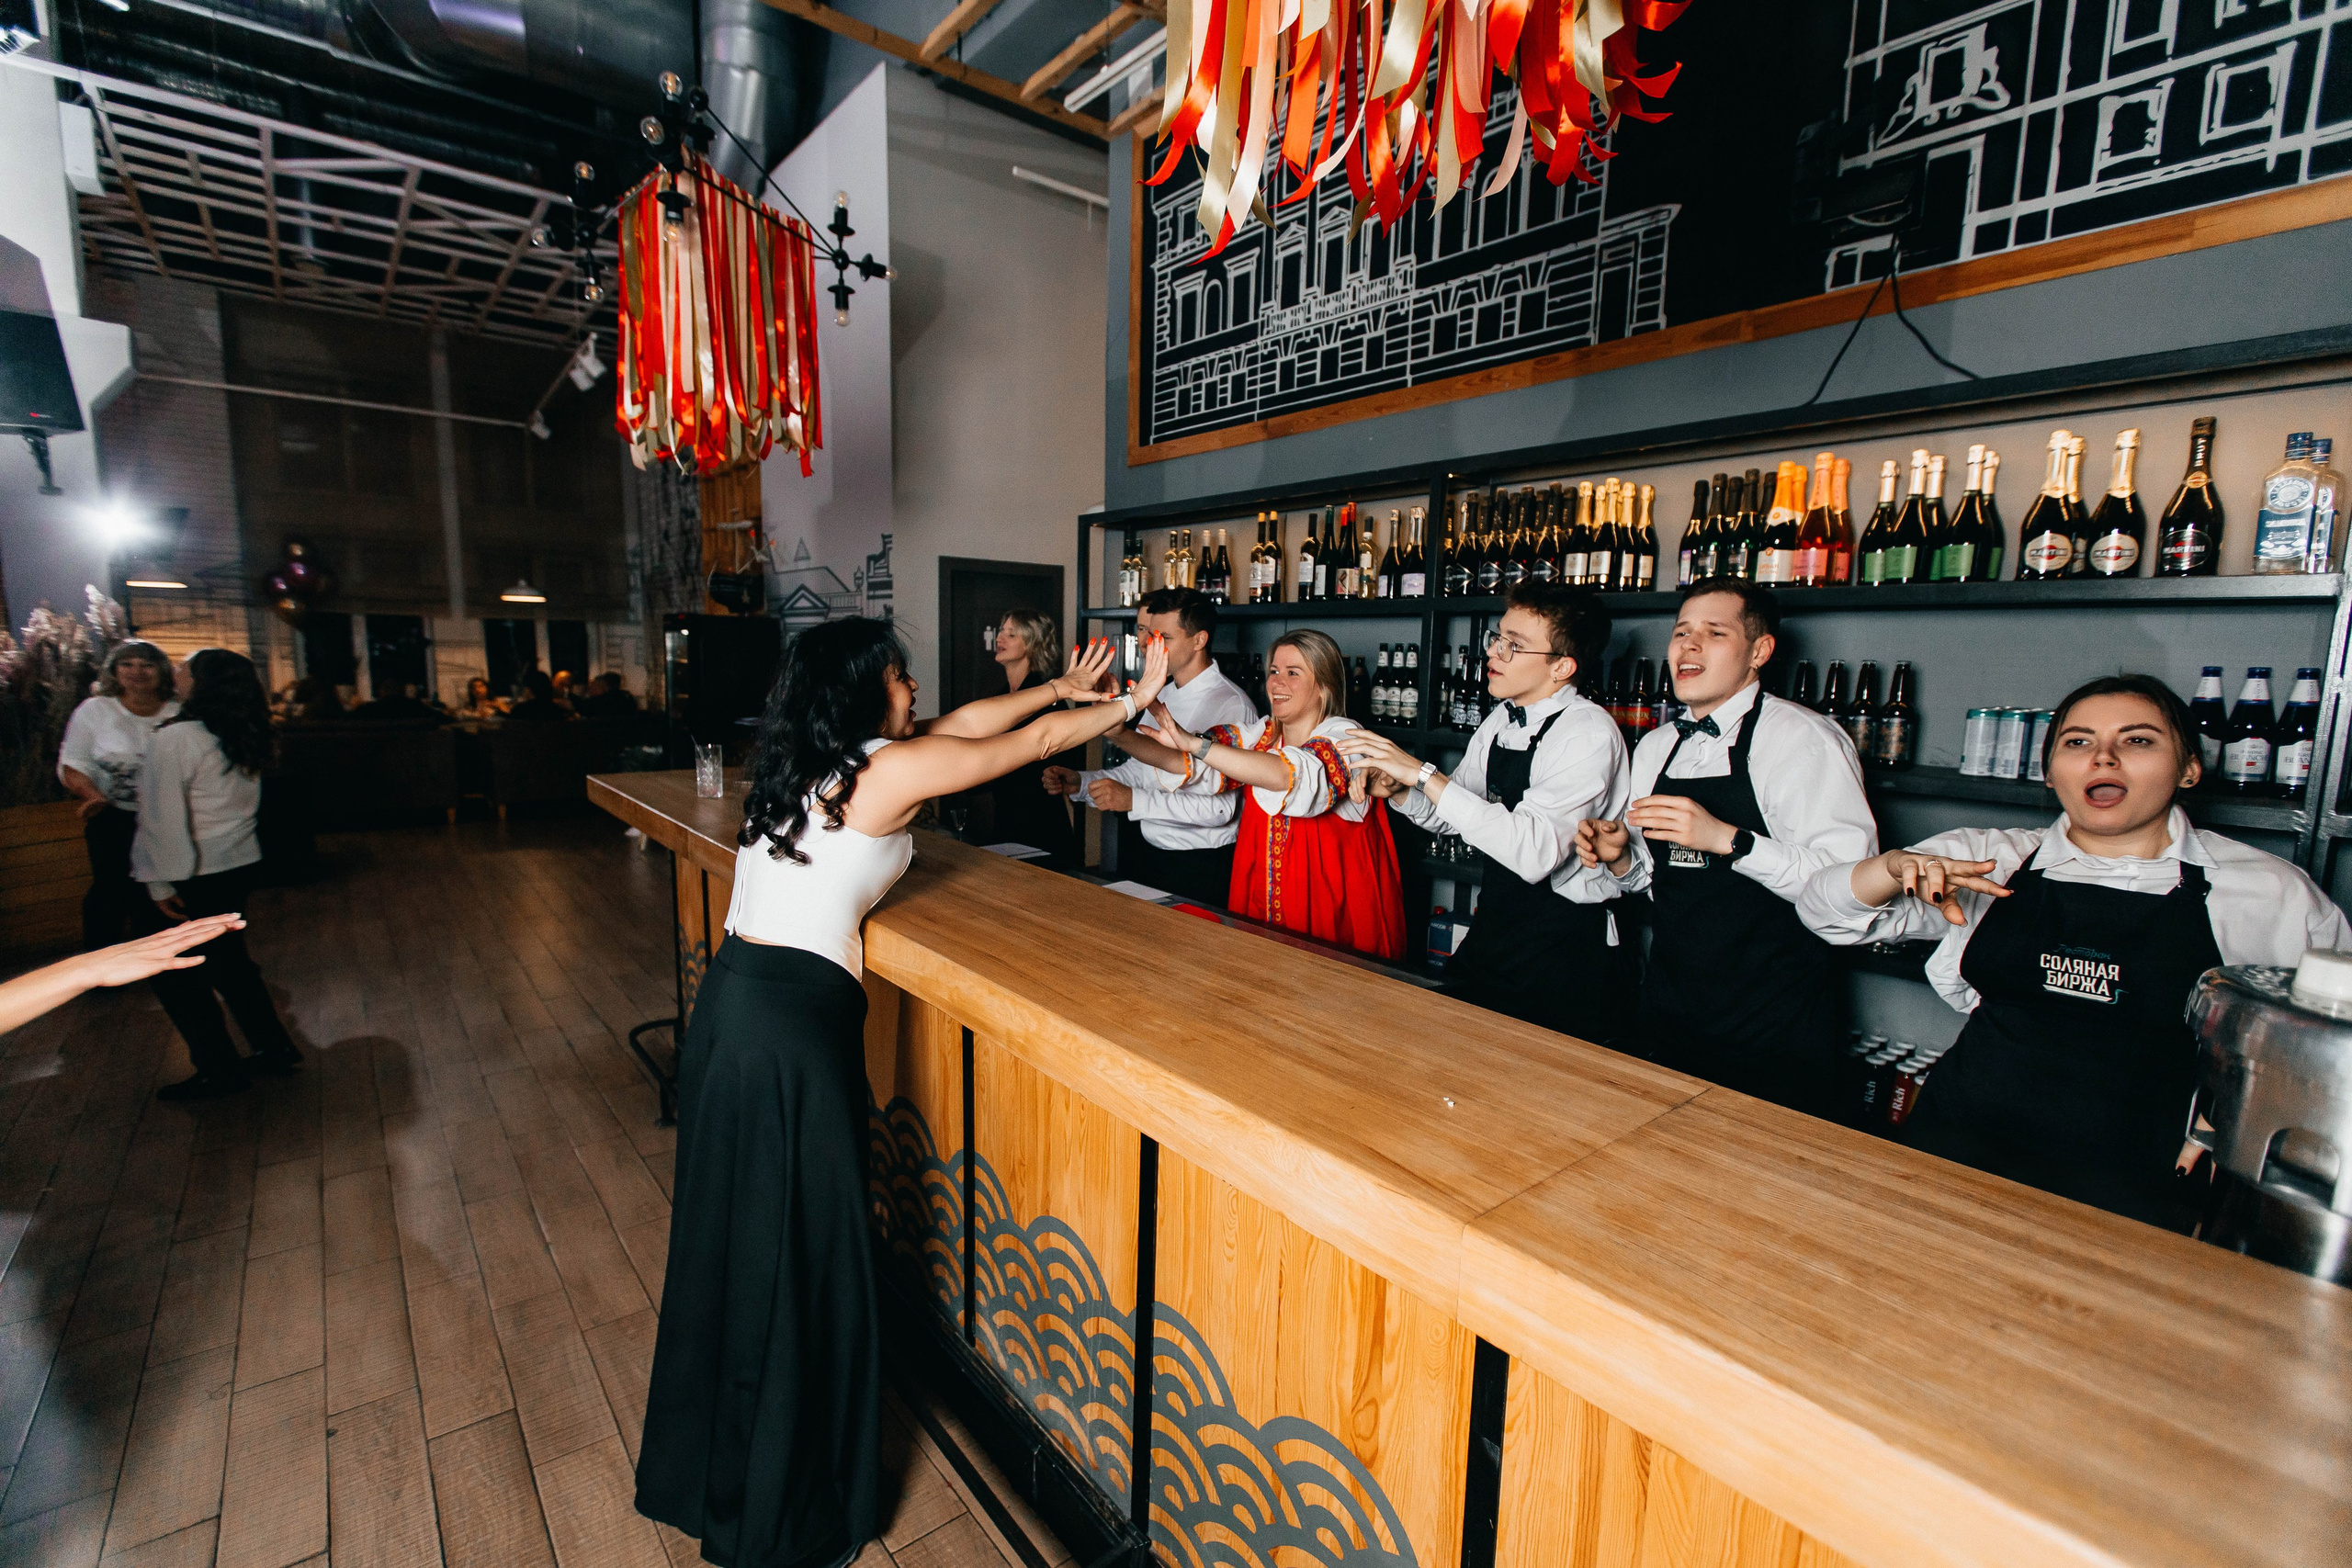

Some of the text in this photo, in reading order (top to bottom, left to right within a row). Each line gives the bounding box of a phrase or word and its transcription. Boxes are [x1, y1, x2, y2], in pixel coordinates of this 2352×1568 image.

[2194, 437, 2207, 467] BRUT
[2163, 545, 2205, 554] MARTINI
[1669, 850, 1704, 863] БИРЖА
[2054, 943, 2111, 960] Ресторан
[2041, 953, 2120, 981] СОЛЯНАЯ
[2045, 970, 2110, 997] БИРЖА
[1863, 1080, 1876, 1103] Rich
[1892, 1087, 1905, 1111] Rich
